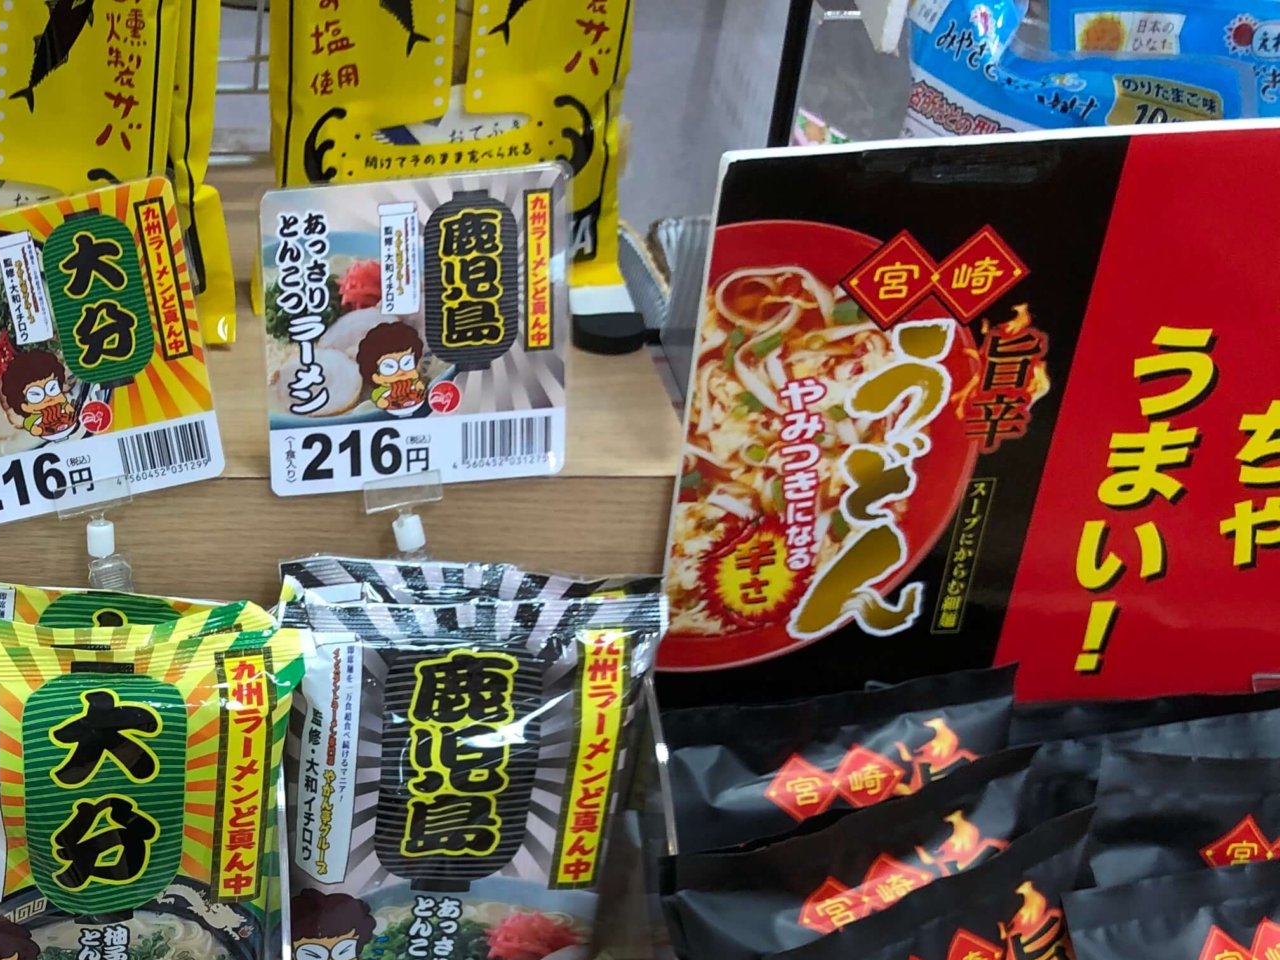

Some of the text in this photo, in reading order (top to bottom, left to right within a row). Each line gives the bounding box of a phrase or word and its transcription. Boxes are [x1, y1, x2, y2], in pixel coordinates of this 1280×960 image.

[311, 64, 359, 96] 使用
[1137, 19, 1174, 33] 日本の
[1122, 78, 1217, 114] のりたまご味
[61, 233, 136, 367] 大分
[142, 205, 186, 354] 九州ラーメンど真ん中
[278, 214, 305, 311] とんこつ
[303, 212, 328, 311] あっさり
[441, 210, 502, 347] 鹿児島
[529, 195, 547, 346] 九州ラーメンど真ん中
[871, 253, 1003, 300] 宮崎
[288, 314, 329, 415] ラーメン
[963, 327, 1042, 444] 旨辛
[780, 378, 827, 570] やみつきになる
[789, 319, 955, 638] うどん
[733, 537, 778, 605] 辛さ
[51, 692, 161, 888] 大分
[221, 659, 264, 895] 九州ラーメンど真ん中
[301, 708, 323, 861] 監修・大和イチロウ
[403, 651, 517, 856] 鹿児島
[784, 762, 887, 807] 宮崎
